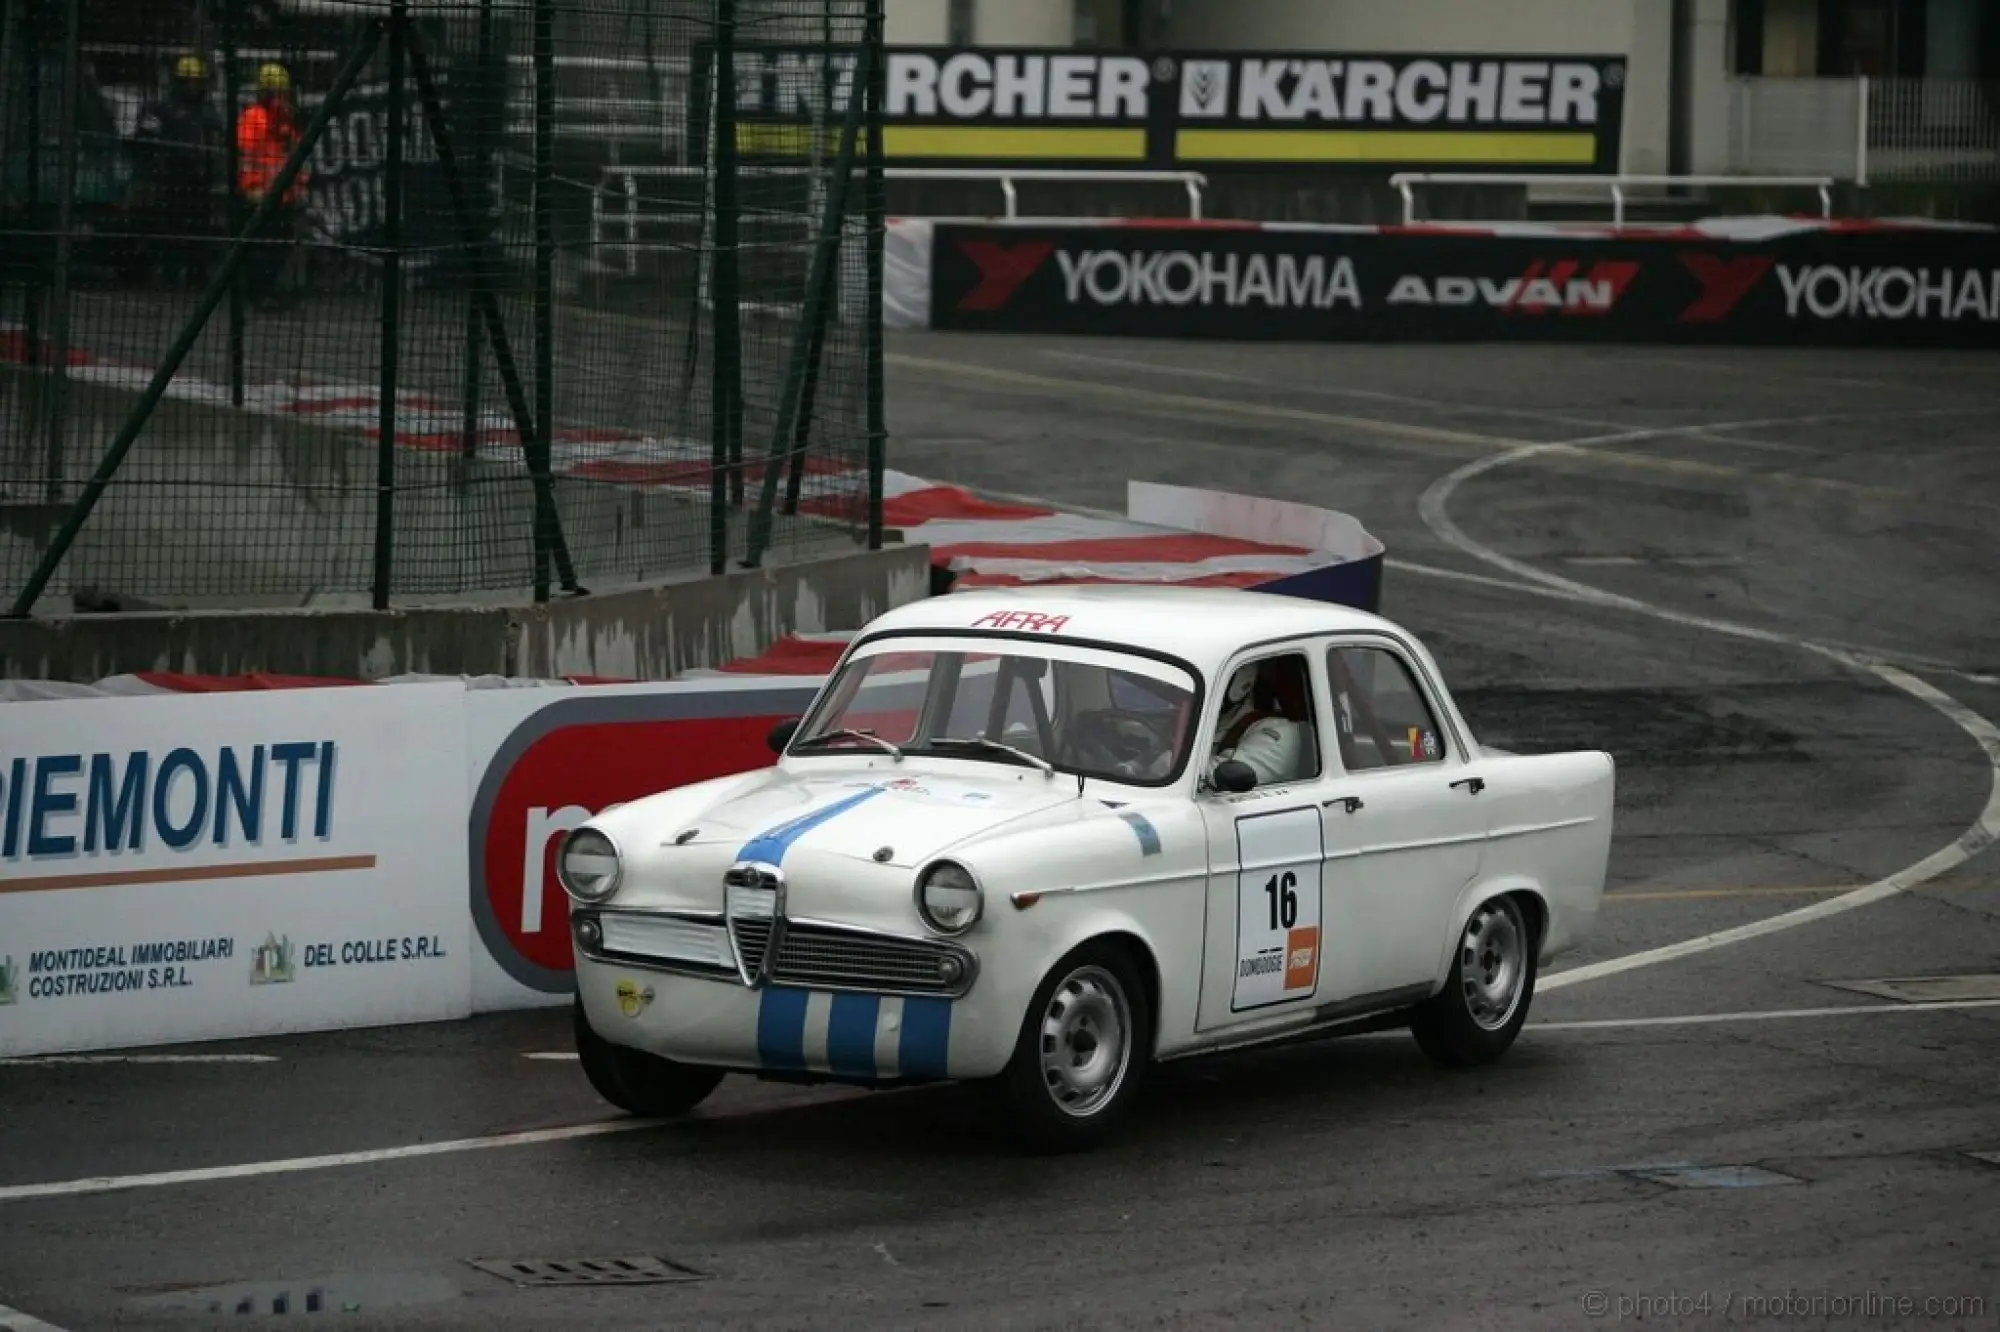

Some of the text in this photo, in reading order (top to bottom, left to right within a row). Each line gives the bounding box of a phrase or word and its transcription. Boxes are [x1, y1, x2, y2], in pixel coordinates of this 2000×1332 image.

[1238, 57, 1598, 123] KÄRCHER
[1056, 249, 1361, 310] YOKOHAMA
[1385, 274, 1614, 309] ADVAN
[972, 610, 1071, 633] AFRA
[0, 740, 338, 860] IEMONTI
[1265, 870, 1298, 930] 16
[28, 941, 234, 973] MONTIDEAL IMMOBILIARI
[304, 935, 446, 967] DEL COLLE S.R.L.
[29, 965, 194, 998] COSTRUZIONI S.R.L.
